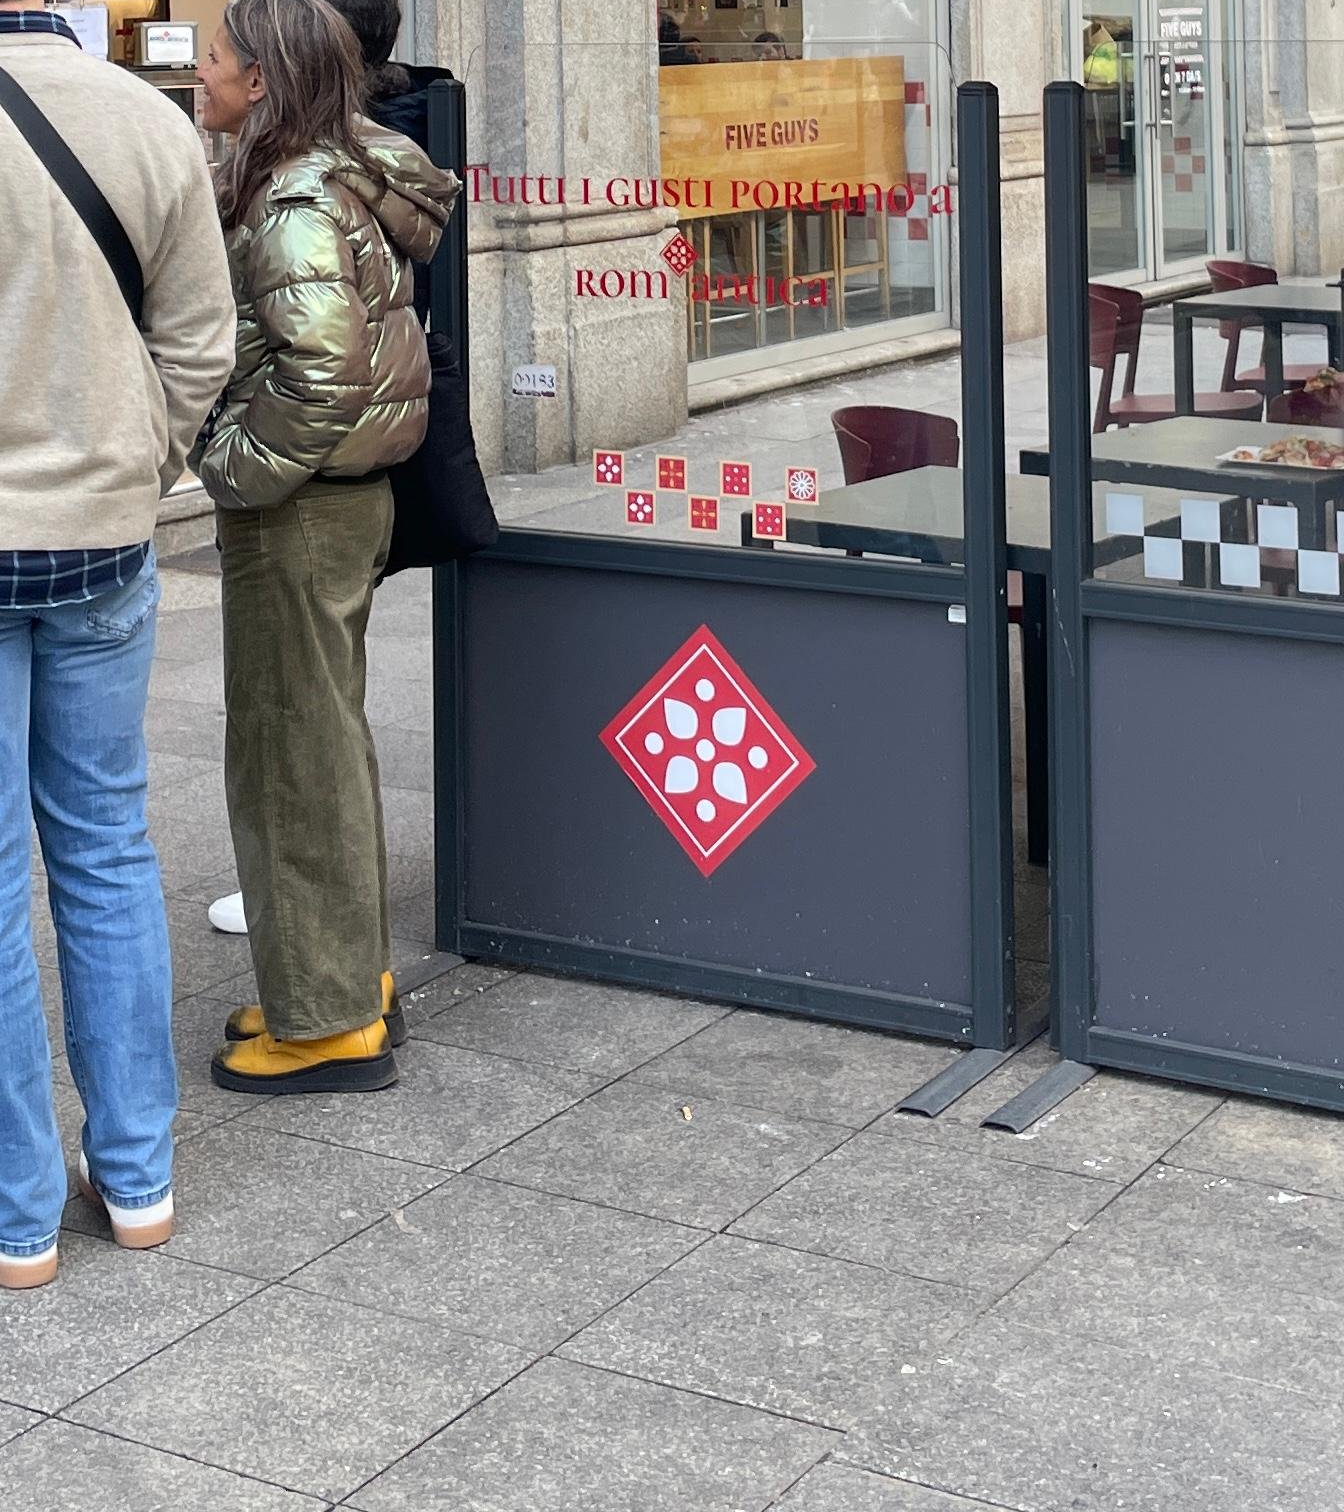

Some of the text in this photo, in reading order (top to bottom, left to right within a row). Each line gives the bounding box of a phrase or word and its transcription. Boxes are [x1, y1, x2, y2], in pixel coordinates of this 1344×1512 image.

[1161, 20, 1202, 38] FIVE GUYS
[725, 118, 819, 151] FIVE GUYS
[929, 184, 955, 216] a
